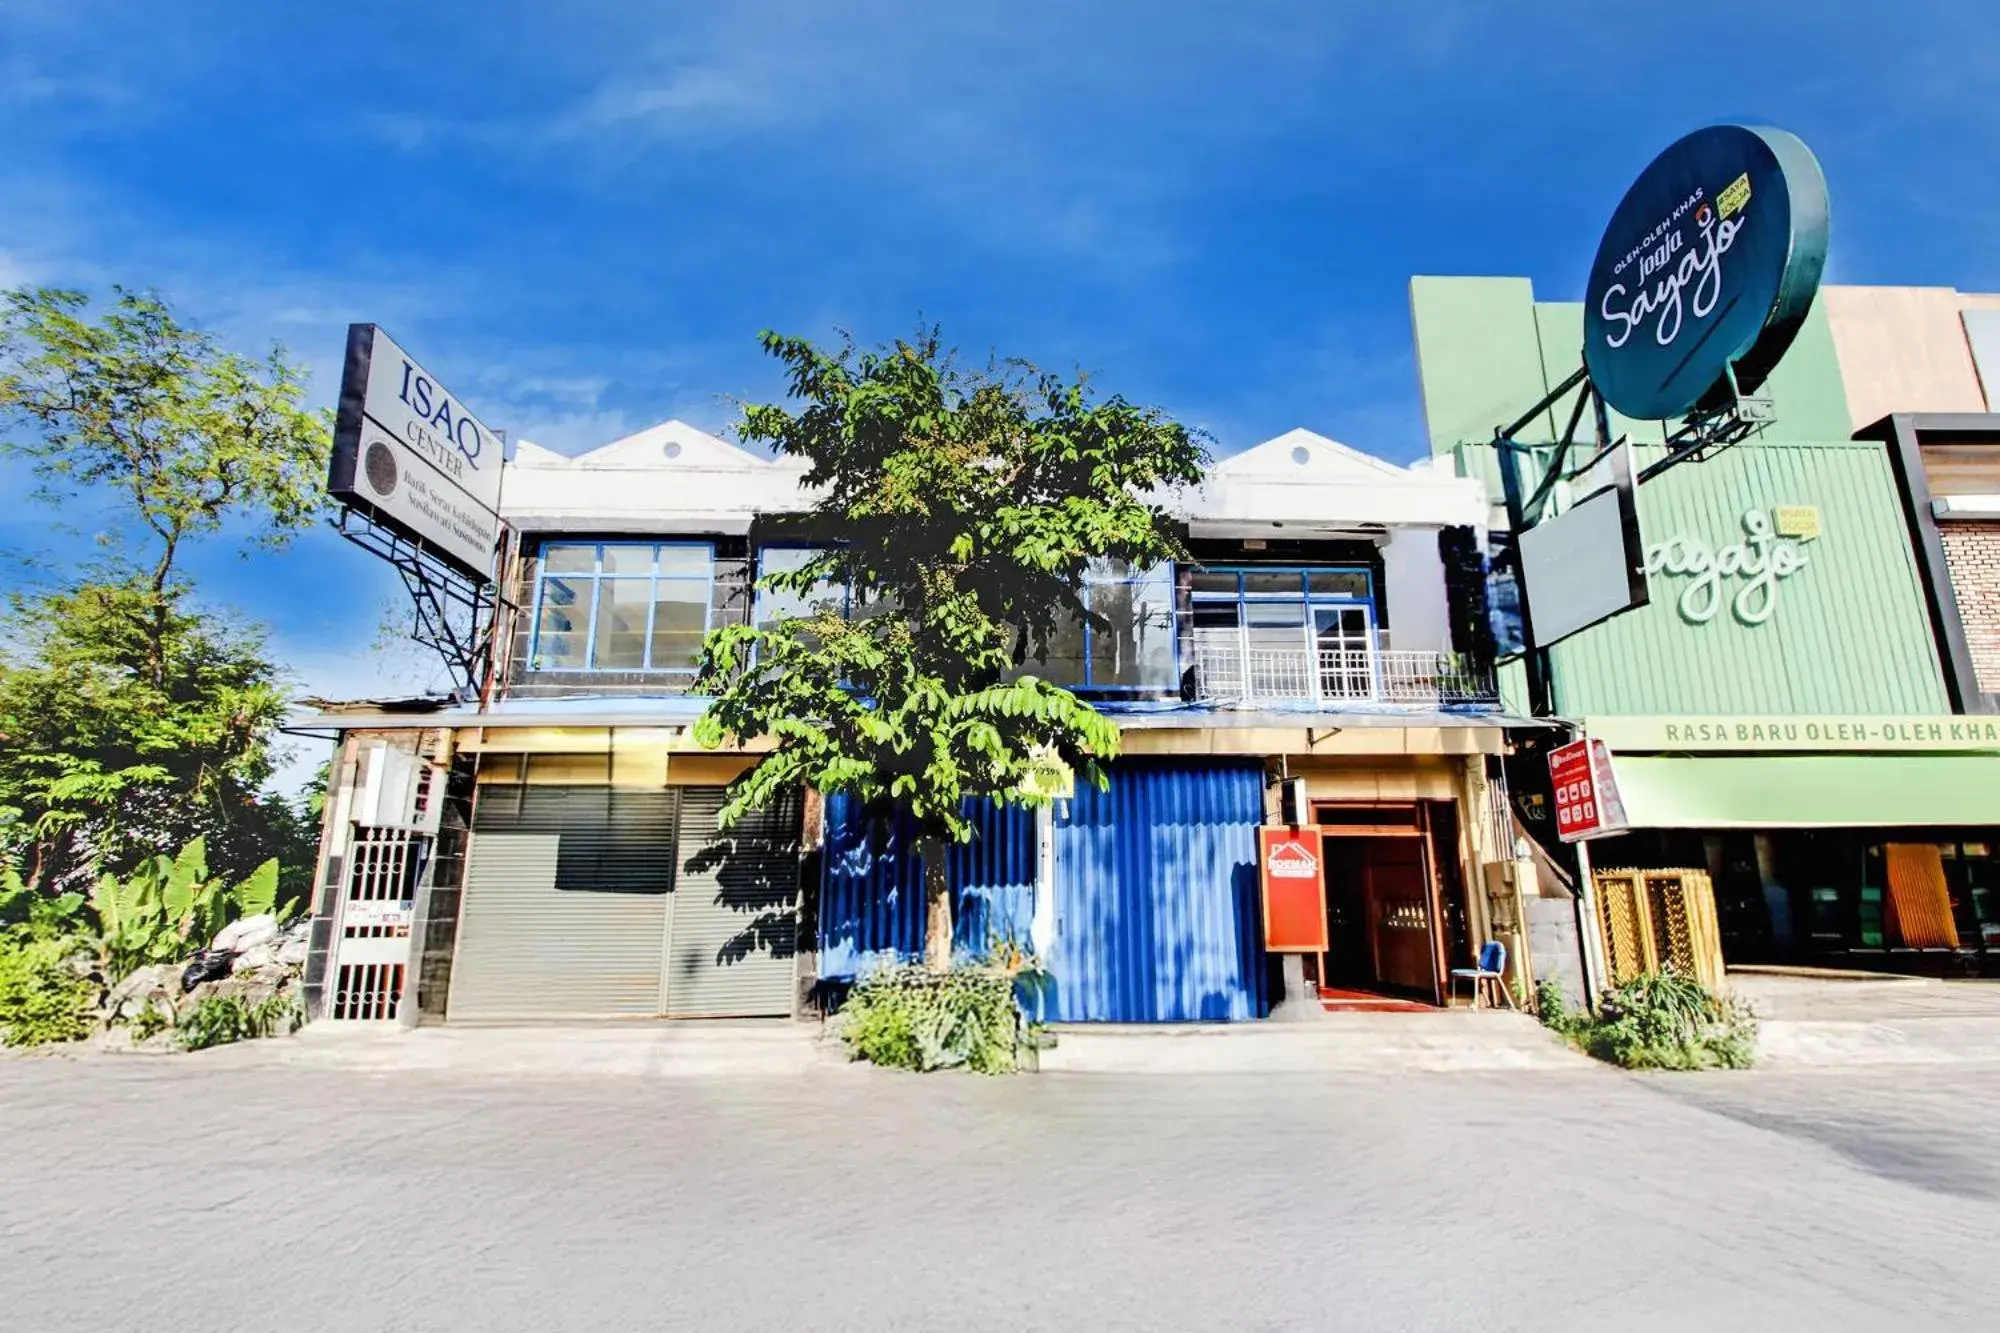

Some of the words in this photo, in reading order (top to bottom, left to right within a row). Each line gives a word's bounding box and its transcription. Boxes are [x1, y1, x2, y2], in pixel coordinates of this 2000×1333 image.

[1613, 217, 1671, 275] OLEH-OLEH
[1672, 187, 1703, 221] KHAS
[399, 360, 480, 471] ISAQ
[407, 420, 463, 479] CENTER
[1637, 509, 1809, 624] ayajo
[1665, 723, 1729, 741] RASA
[1735, 723, 1798, 741] BARU
[1805, 722, 1943, 741] OLEH-OLEH
[1950, 723, 2000, 741] KHA
